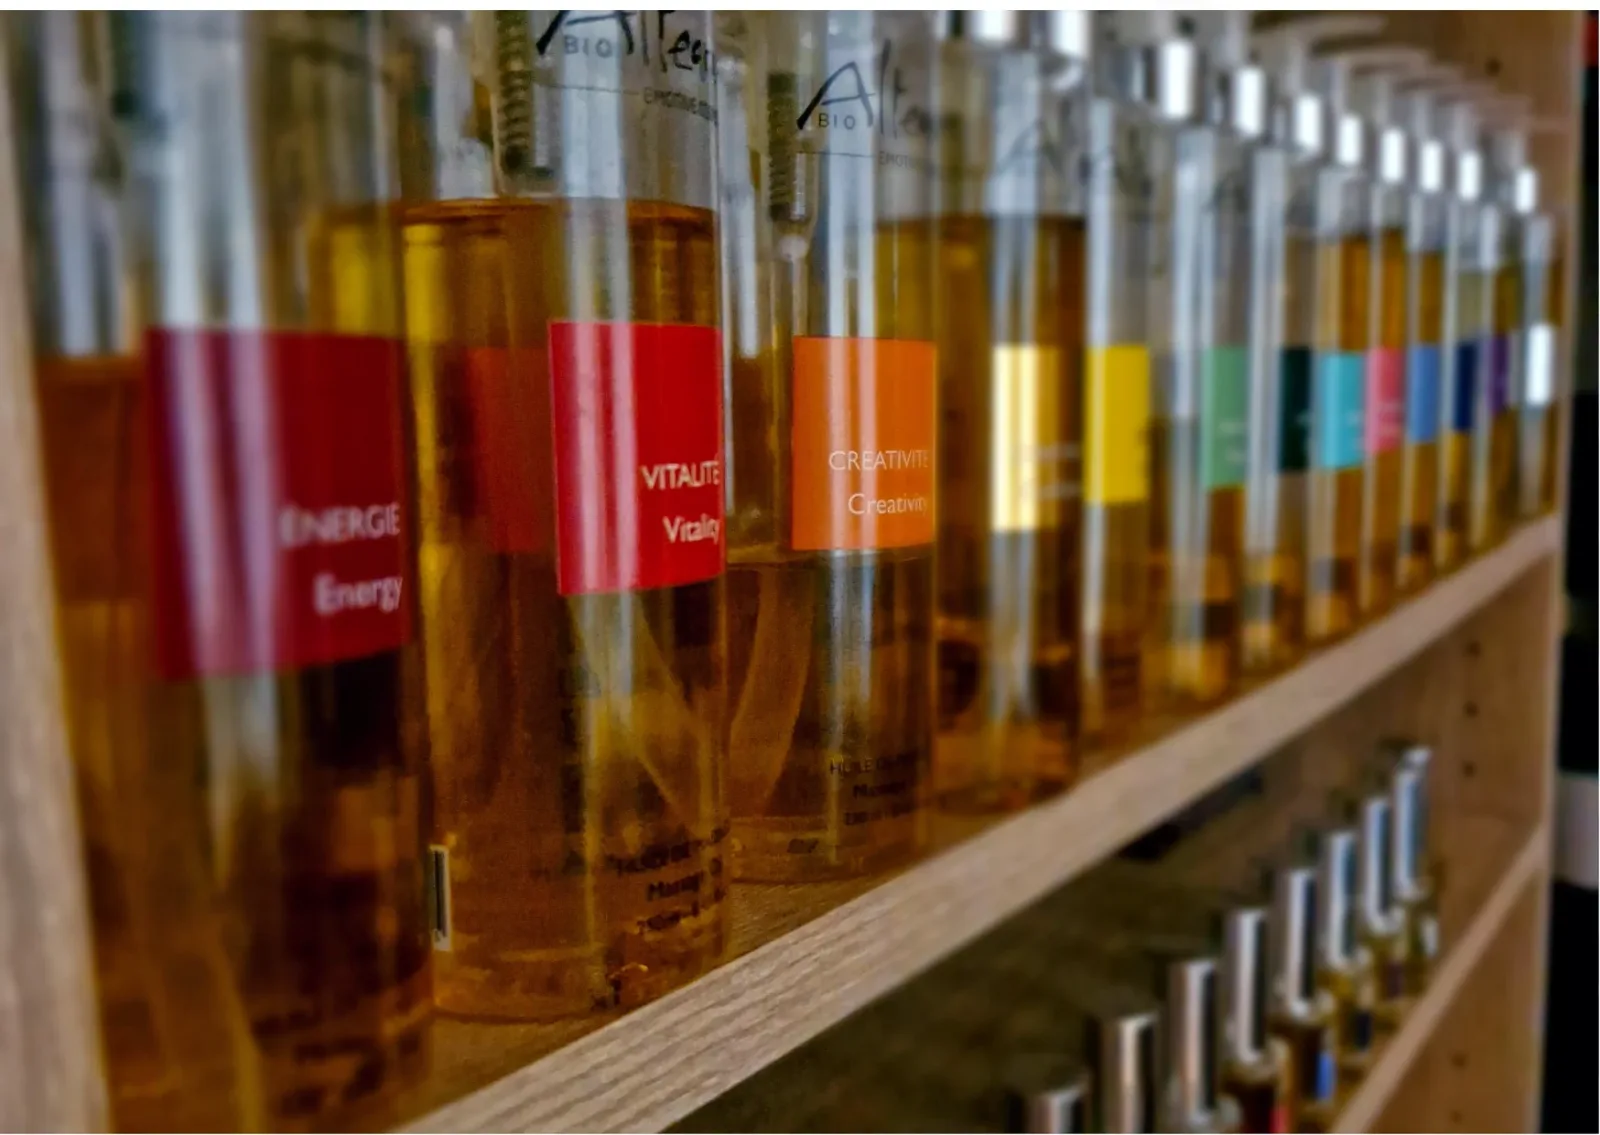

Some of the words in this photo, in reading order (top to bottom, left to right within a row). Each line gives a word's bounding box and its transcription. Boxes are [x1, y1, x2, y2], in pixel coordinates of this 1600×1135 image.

[563, 34, 613, 58] BIO
[818, 113, 856, 130] BIO
[848, 493, 928, 516] Creativity
[661, 513, 720, 545] Vitality
[314, 574, 403, 614] Energy
